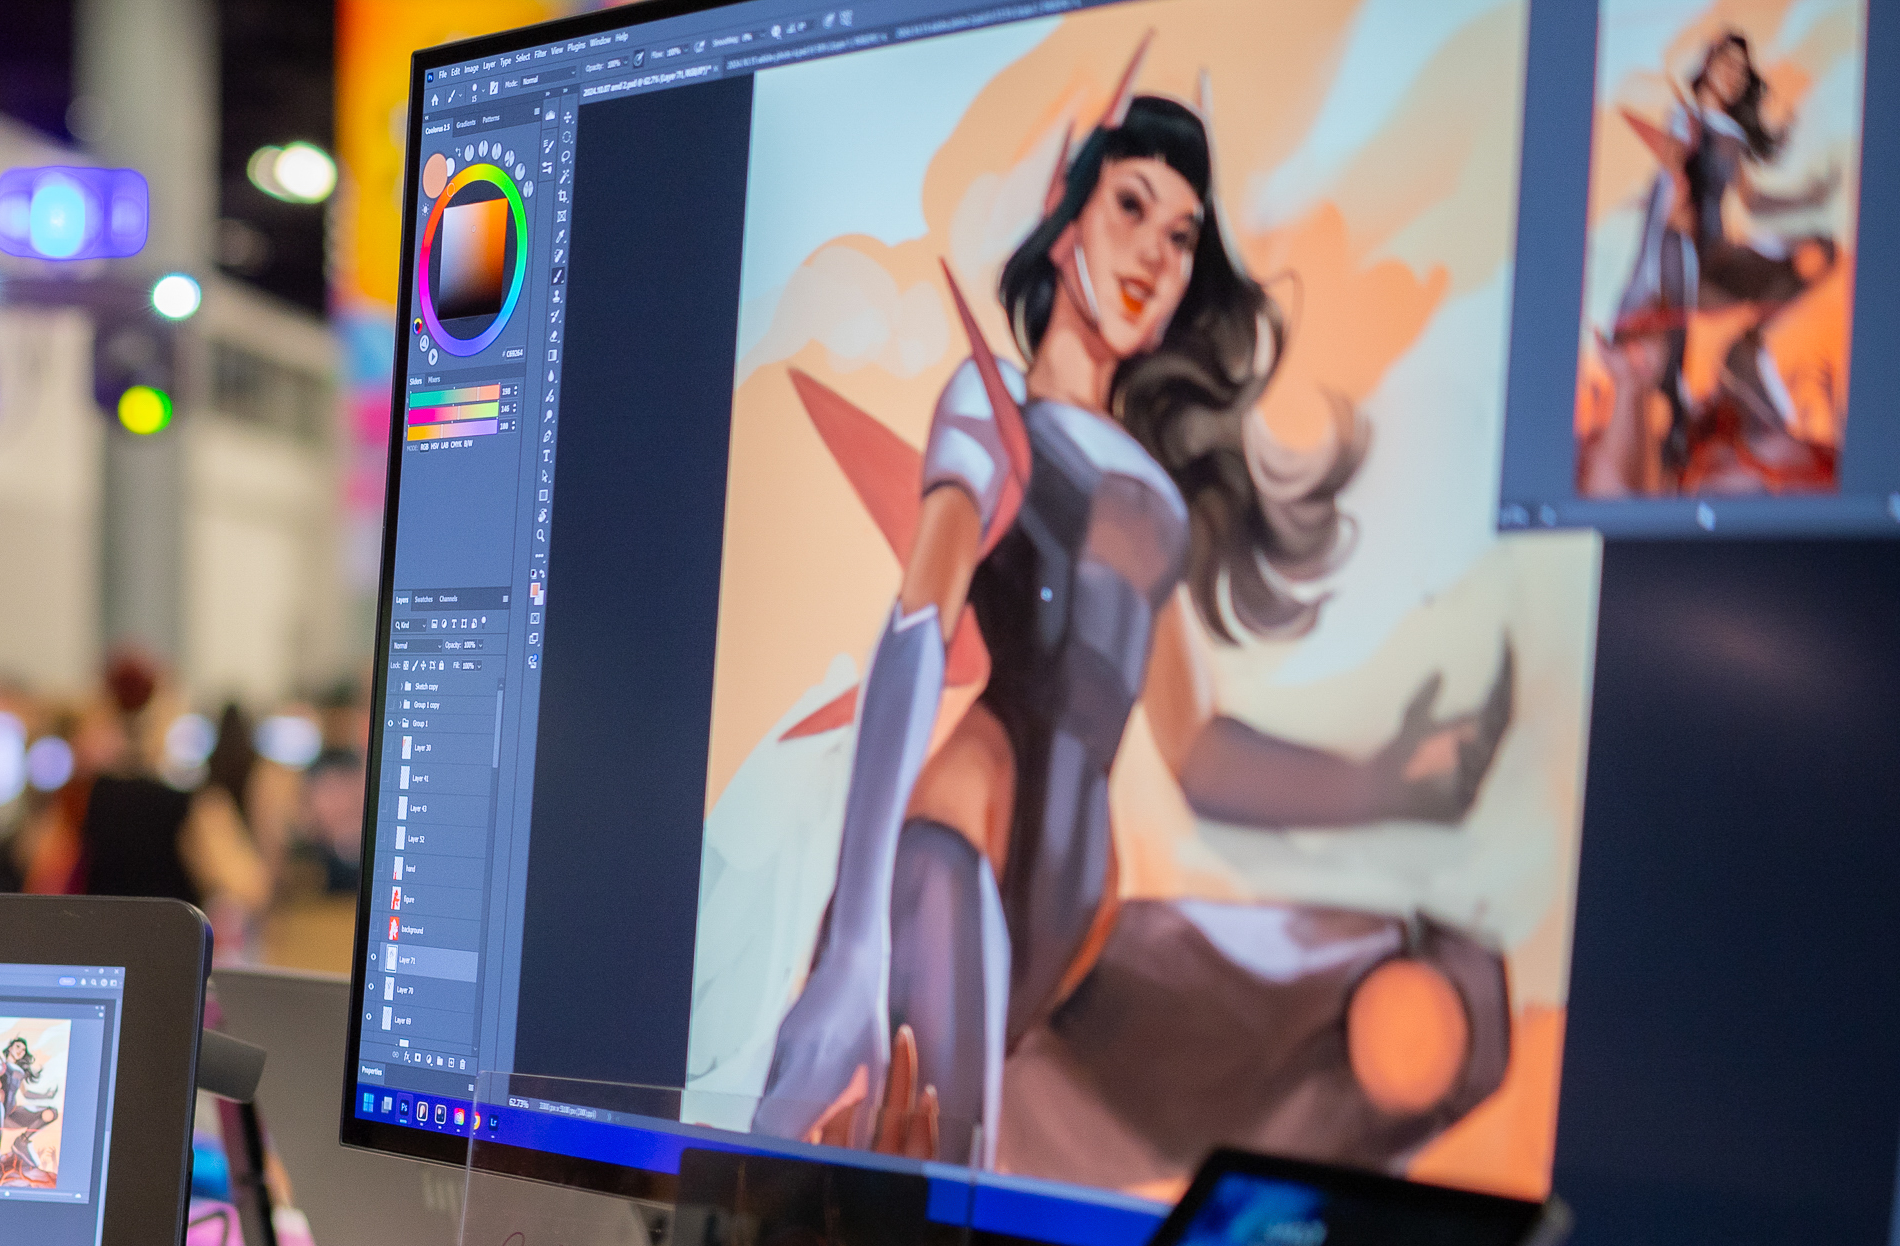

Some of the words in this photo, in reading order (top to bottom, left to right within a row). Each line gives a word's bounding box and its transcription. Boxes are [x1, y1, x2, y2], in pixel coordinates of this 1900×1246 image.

[439, 70, 447, 79] File
[451, 68, 460, 76] Edit
[464, 64, 479, 75] Image
[483, 61, 496, 71] Layer
[500, 57, 511, 68] Type
[516, 52, 530, 63] Select
[534, 49, 547, 58] Filter
[551, 46, 564, 55] View
[567, 42, 586, 52] Plugins
[590, 36, 611, 47] Window
[615, 32, 629, 42] Help
[585, 63, 604, 72] Opacity:
[505, 80, 518, 88] Mode:
[523, 76, 538, 85] Normal
[482, 115, 500, 123] Patterns
[456, 120, 476, 129] Gradients
[410, 378, 422, 386] Sliders
[428, 376, 441, 384] Mixers
[396, 596, 408, 604] Layers
[445, 642, 461, 650] Opacity:
[414, 701, 426, 709] Group
[413, 720, 425, 728] Group
[415, 744, 425, 752] Layer
[412, 775, 423, 783] Layer
[410, 805, 421, 813] Layer
[408, 835, 418, 843] Layer
[406, 865, 416, 873] hand
[404, 896, 414, 904] figure
[401, 925, 423, 935] background
[399, 956, 410, 964] Layer
[397, 986, 408, 994] Layer
[394, 1016, 406, 1025] Layer
[362, 1066, 383, 1076] Properties
[509, 1098, 529, 1108] 62.73%
